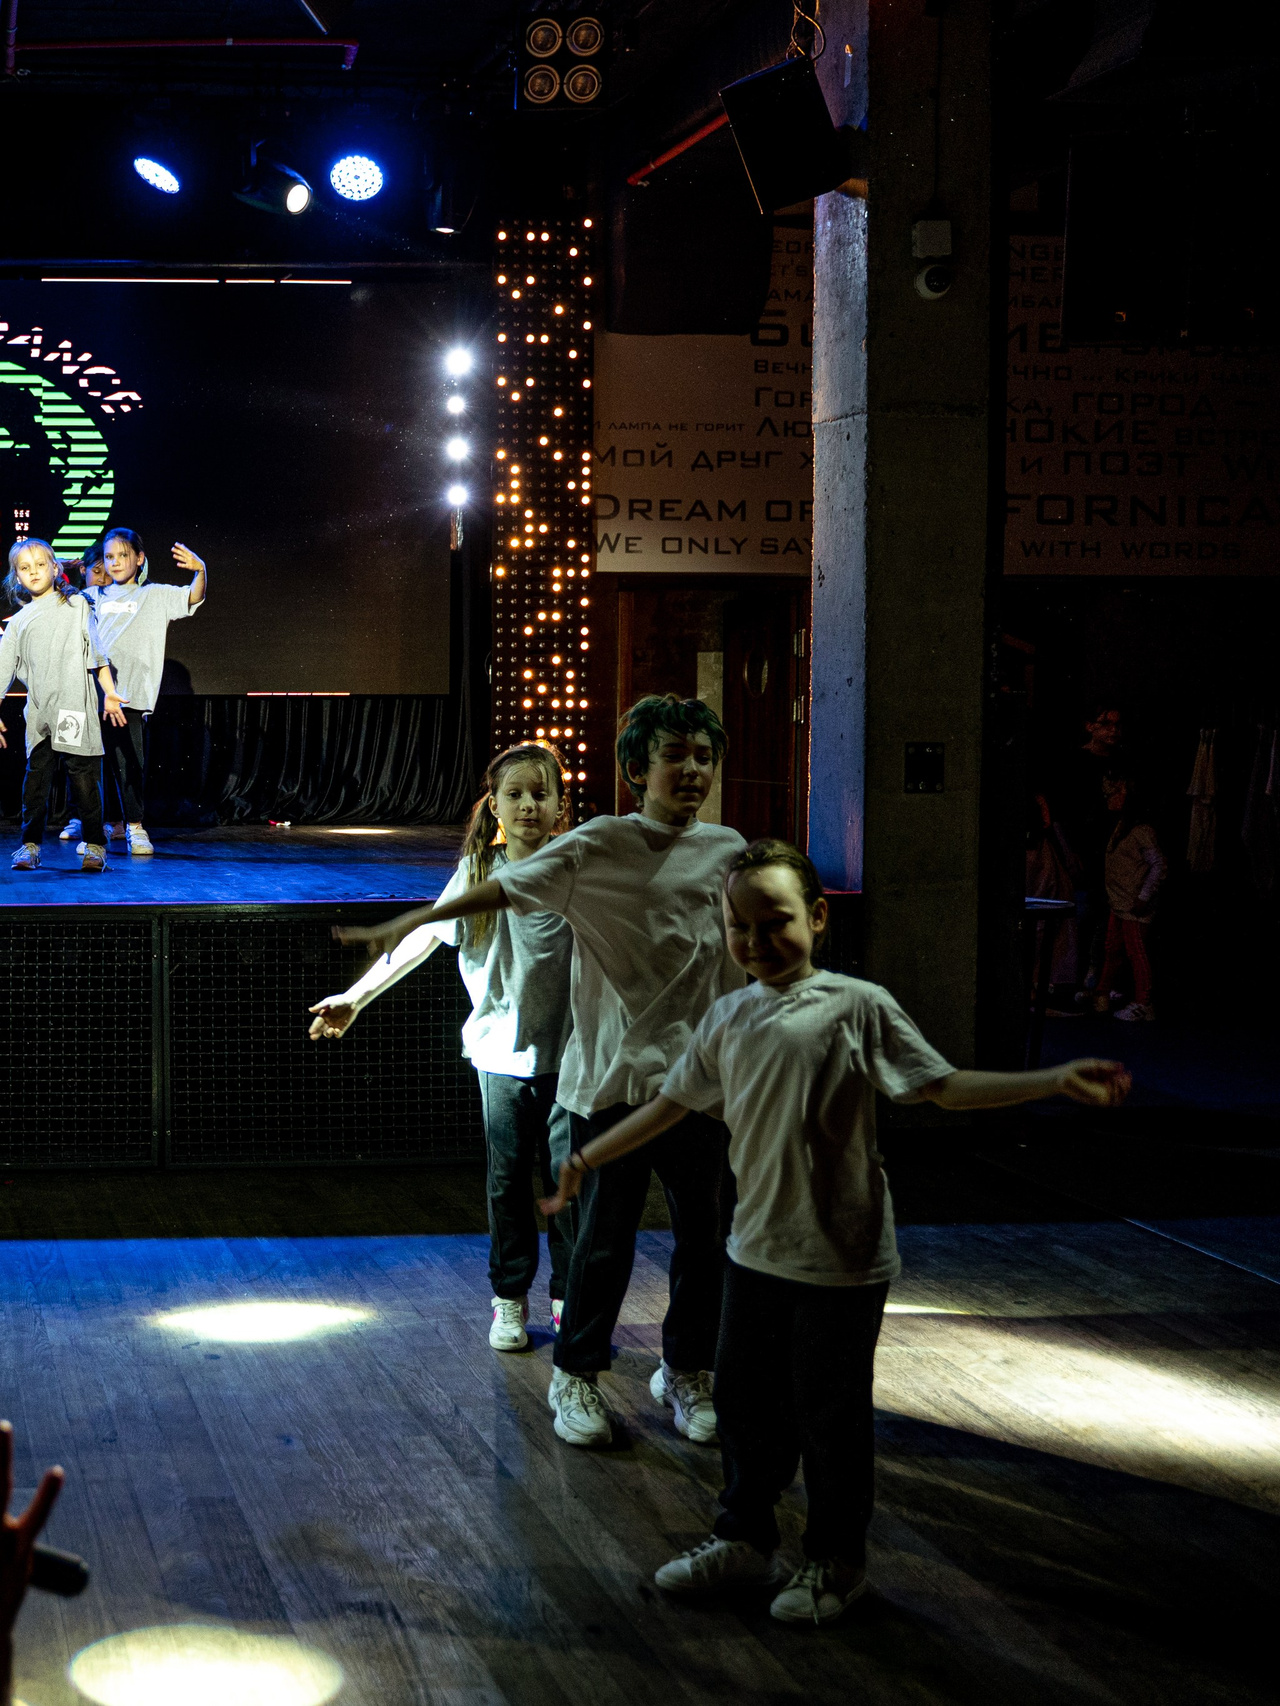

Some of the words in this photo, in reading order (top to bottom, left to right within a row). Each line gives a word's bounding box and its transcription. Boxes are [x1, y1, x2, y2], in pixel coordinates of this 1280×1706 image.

[608, 422, 662, 431] ЛАМПА
[668, 423, 688, 431] НЕ
[695, 423, 745, 432] ГОРИТ
[690, 450, 783, 472] ДРУГ
[593, 493, 747, 522] DREAM
[661, 537, 748, 555] ONLY
[1021, 540, 1102, 559] WITH
[1120, 542, 1241, 560] WORDS
